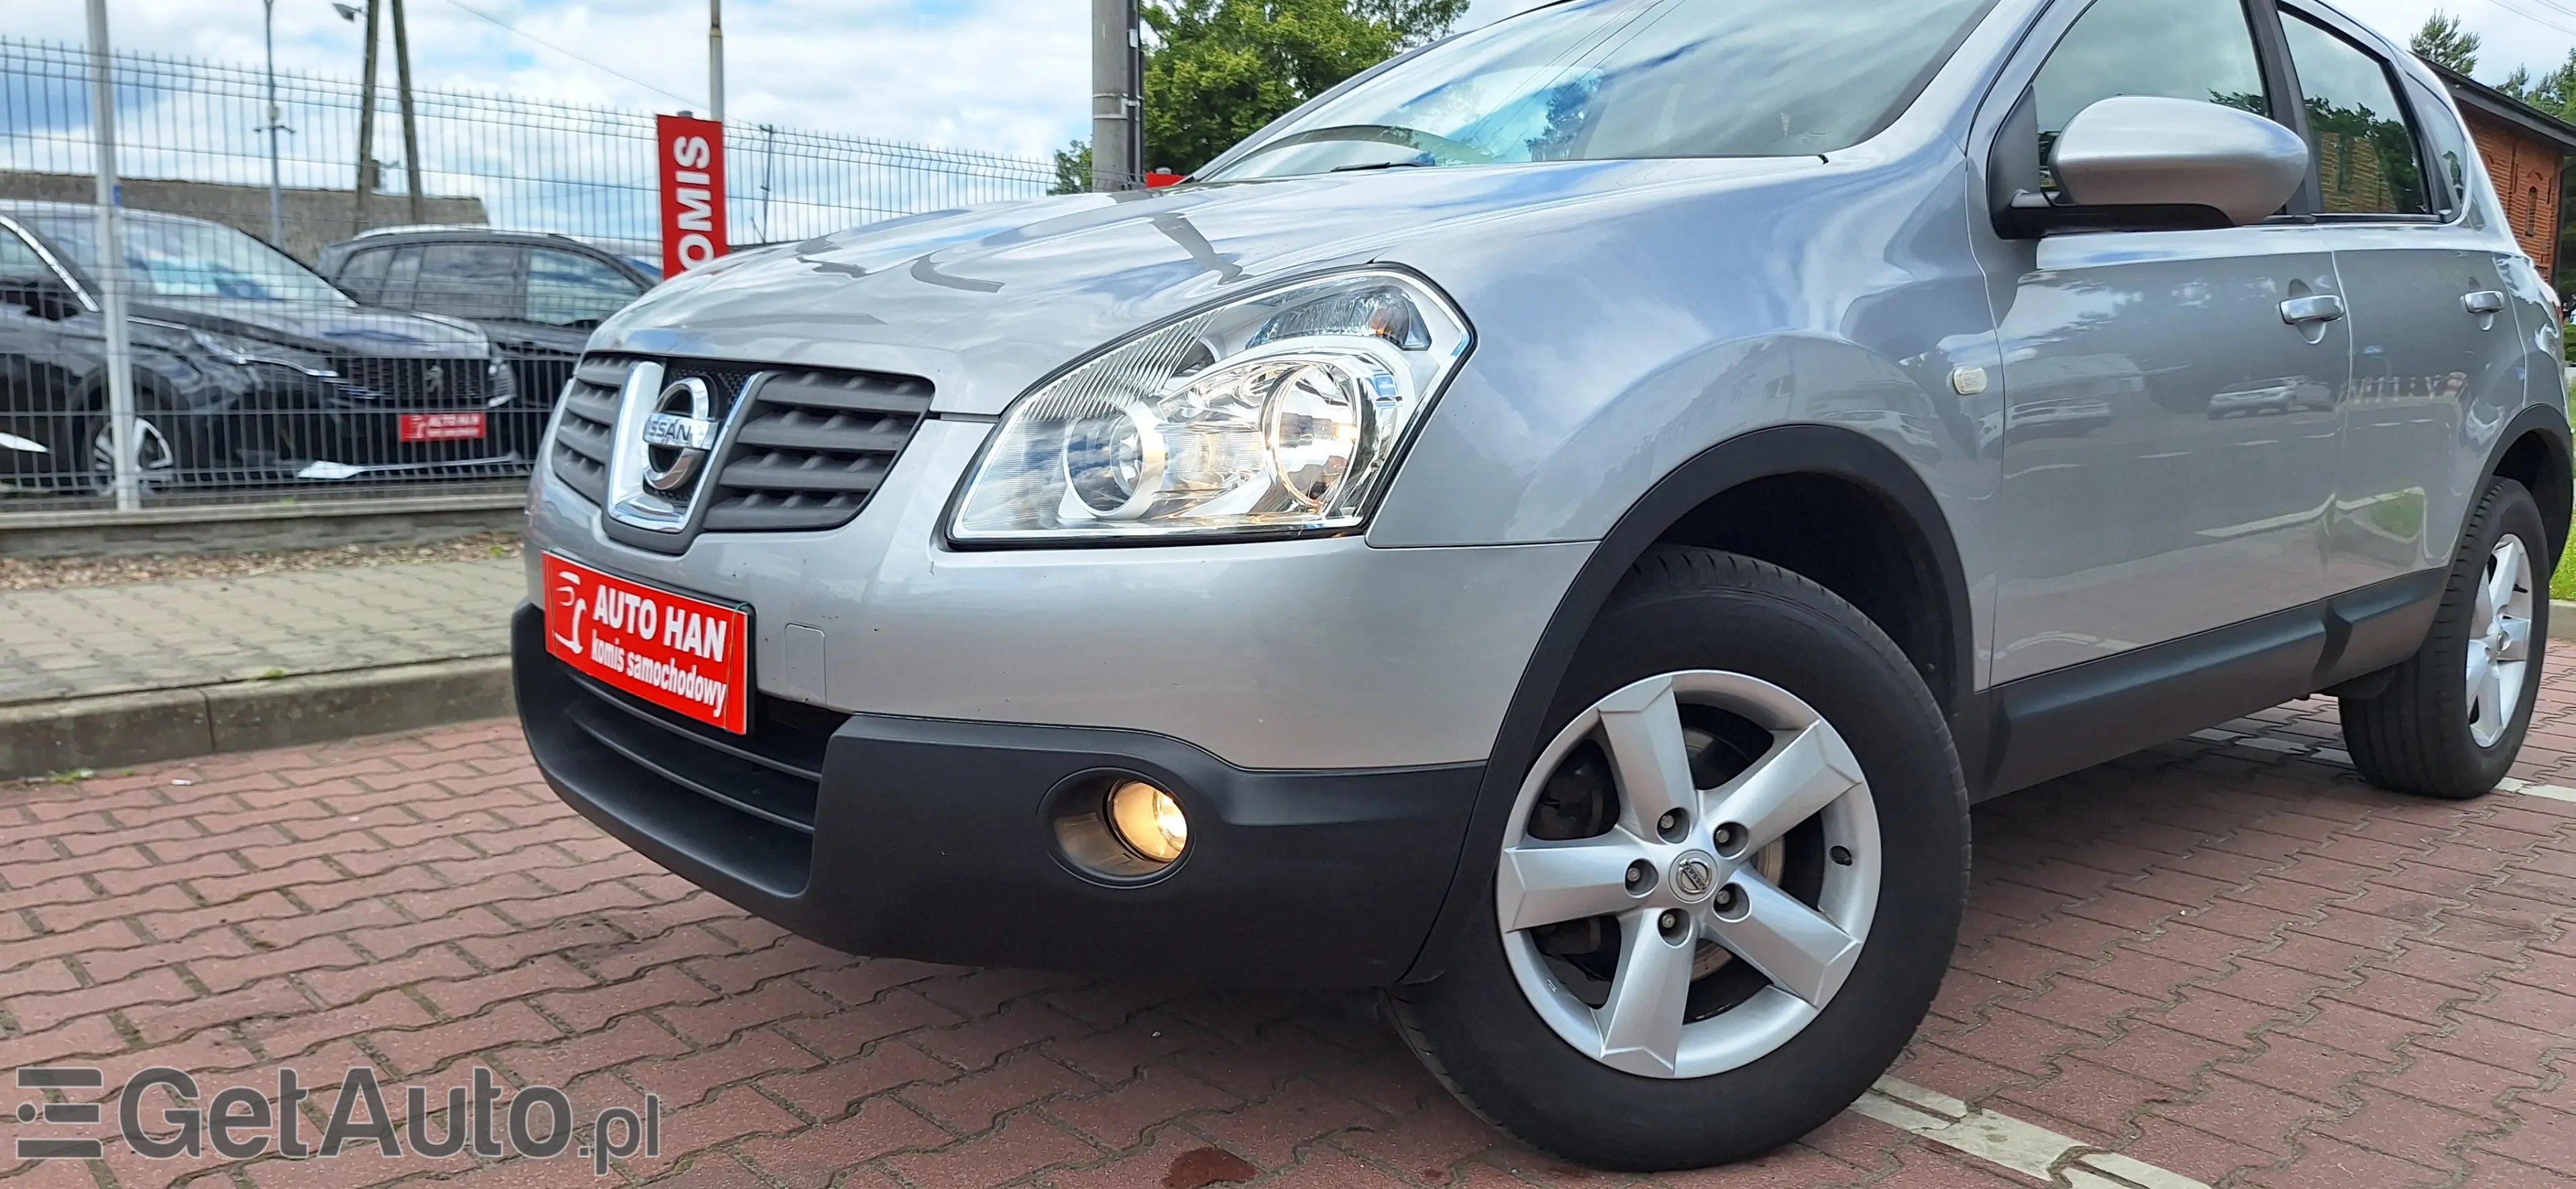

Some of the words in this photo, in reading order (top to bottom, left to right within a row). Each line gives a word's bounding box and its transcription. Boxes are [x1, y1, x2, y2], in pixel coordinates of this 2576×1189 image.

[674, 135, 714, 272] OMIS
[648, 420, 692, 441] SSAN
[593, 584, 657, 640] AUTO
[663, 606, 727, 663] HAN
[591, 628, 625, 673] komis
[627, 651, 727, 718] samochodowy
[1684, 861, 1707, 891] NISSAN
